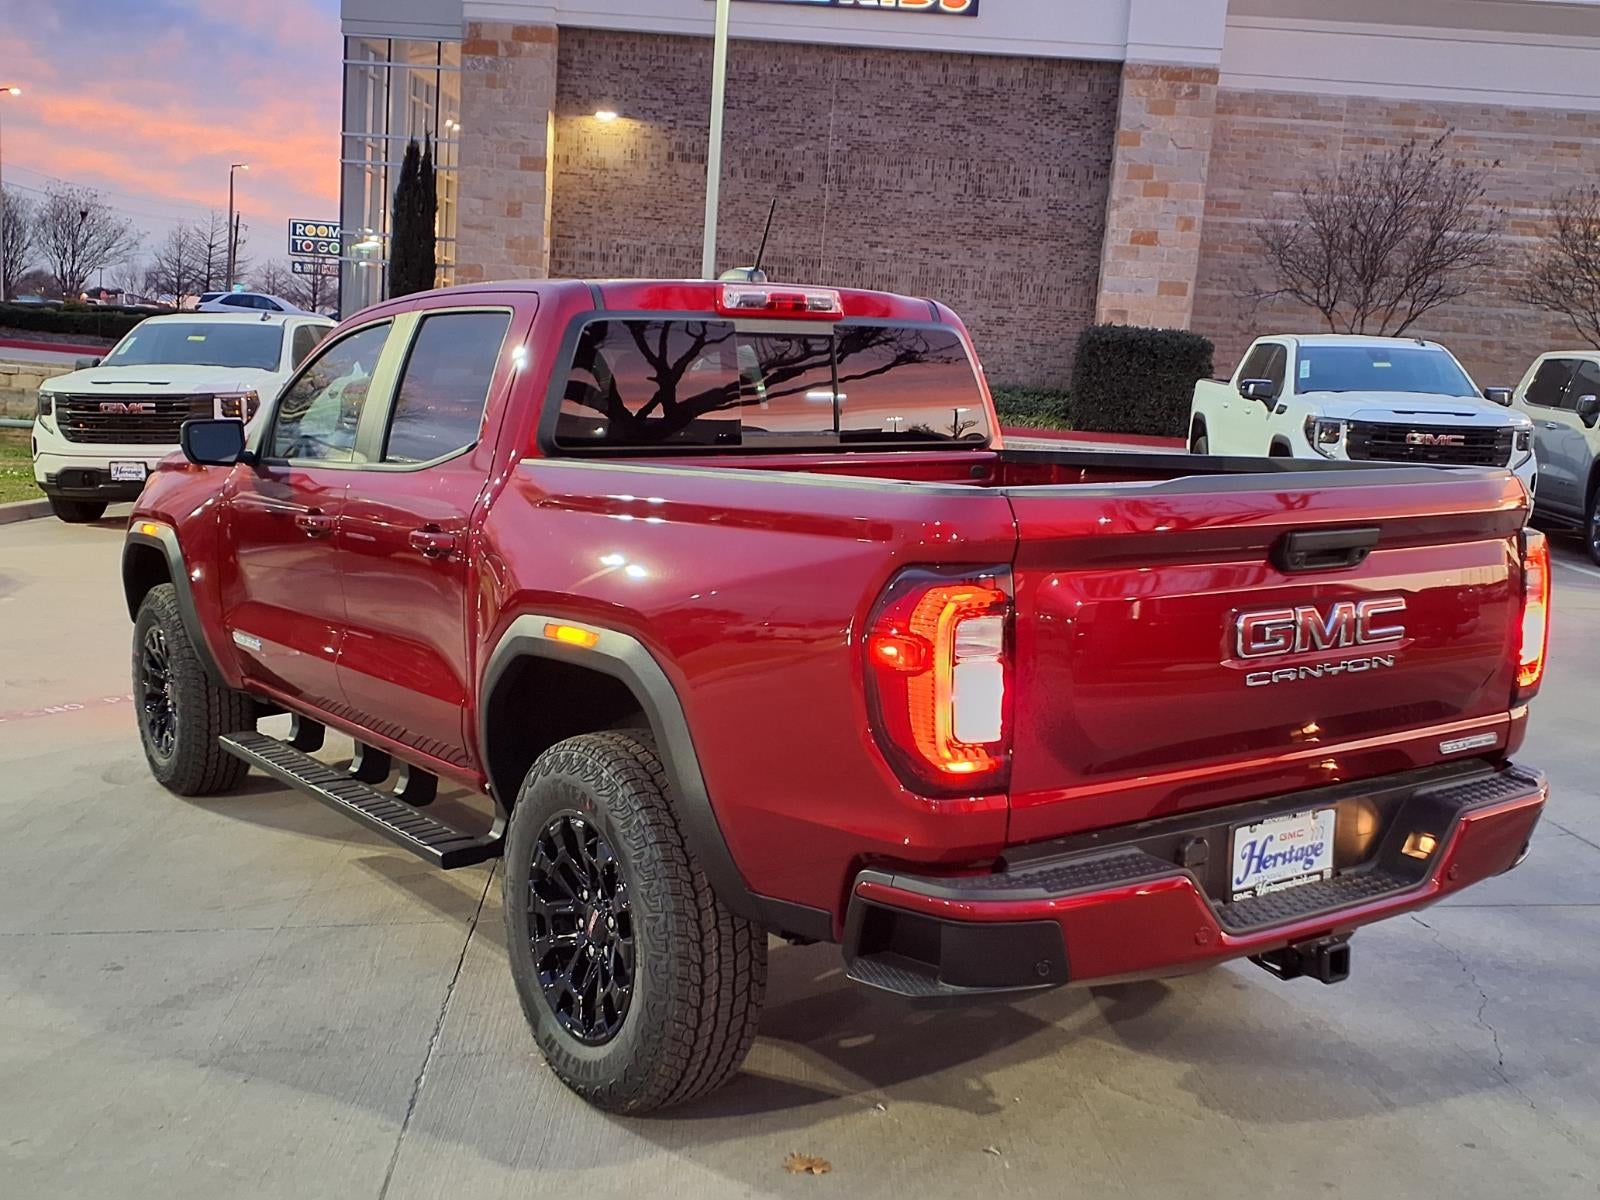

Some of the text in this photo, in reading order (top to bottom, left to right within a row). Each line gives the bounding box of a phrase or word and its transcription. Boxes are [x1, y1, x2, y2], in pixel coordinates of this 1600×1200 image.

[296, 239, 340, 254] TO GO
[100, 402, 156, 414] GMC
[1406, 433, 1465, 446] GMC
[1237, 597, 1406, 658] GMC
[1246, 654, 1395, 686] CANYON
[1280, 829, 1304, 841] GMC
[1235, 834, 1324, 886] Heritage
